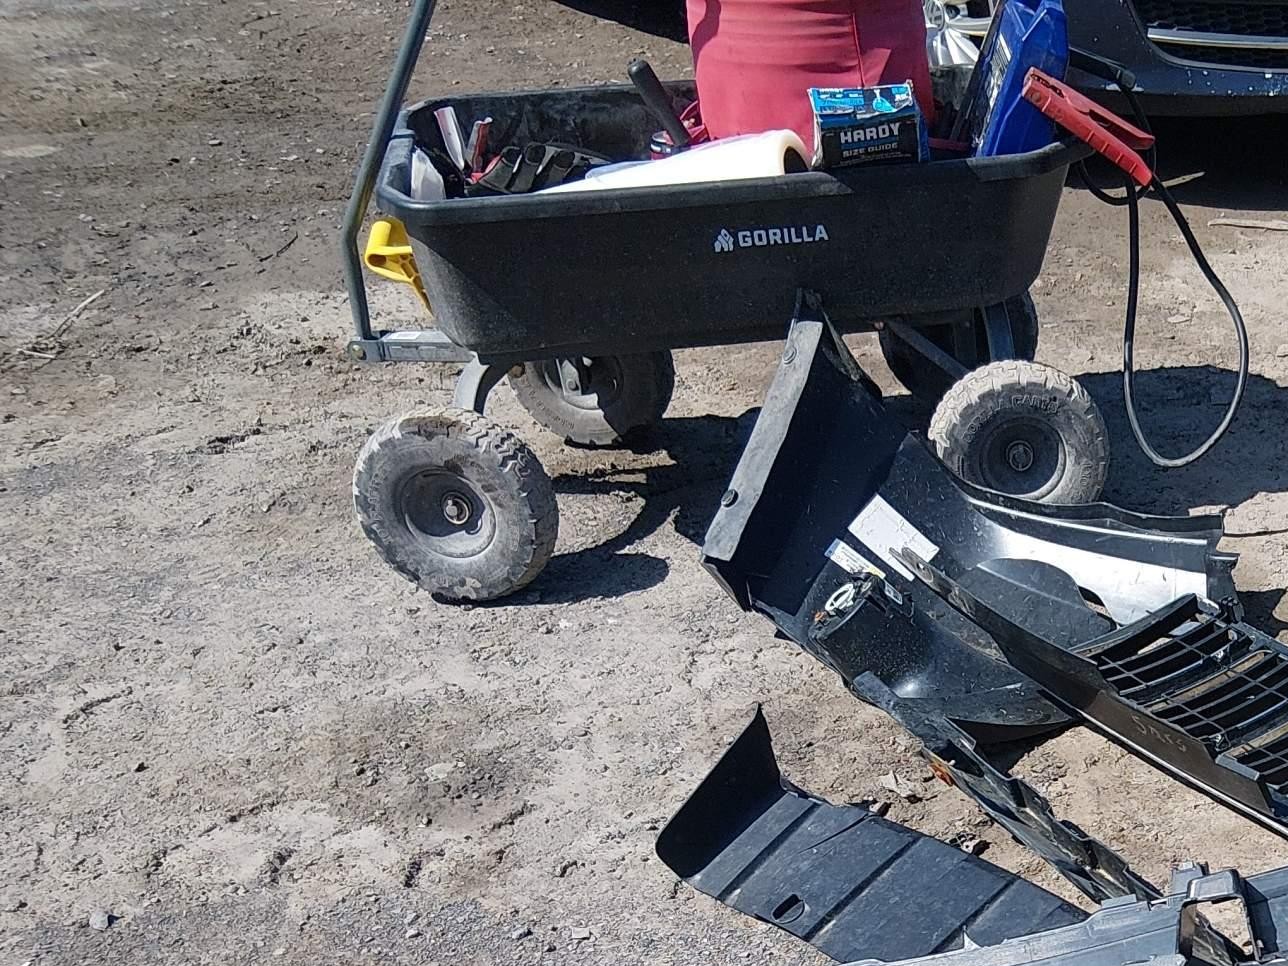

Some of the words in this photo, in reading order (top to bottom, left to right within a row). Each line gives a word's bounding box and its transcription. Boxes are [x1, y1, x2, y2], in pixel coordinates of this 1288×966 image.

[840, 122, 901, 144] HARDY
[842, 147, 866, 158] SIZE
[867, 142, 898, 153] GUIDE
[737, 224, 829, 247] GORILLA
